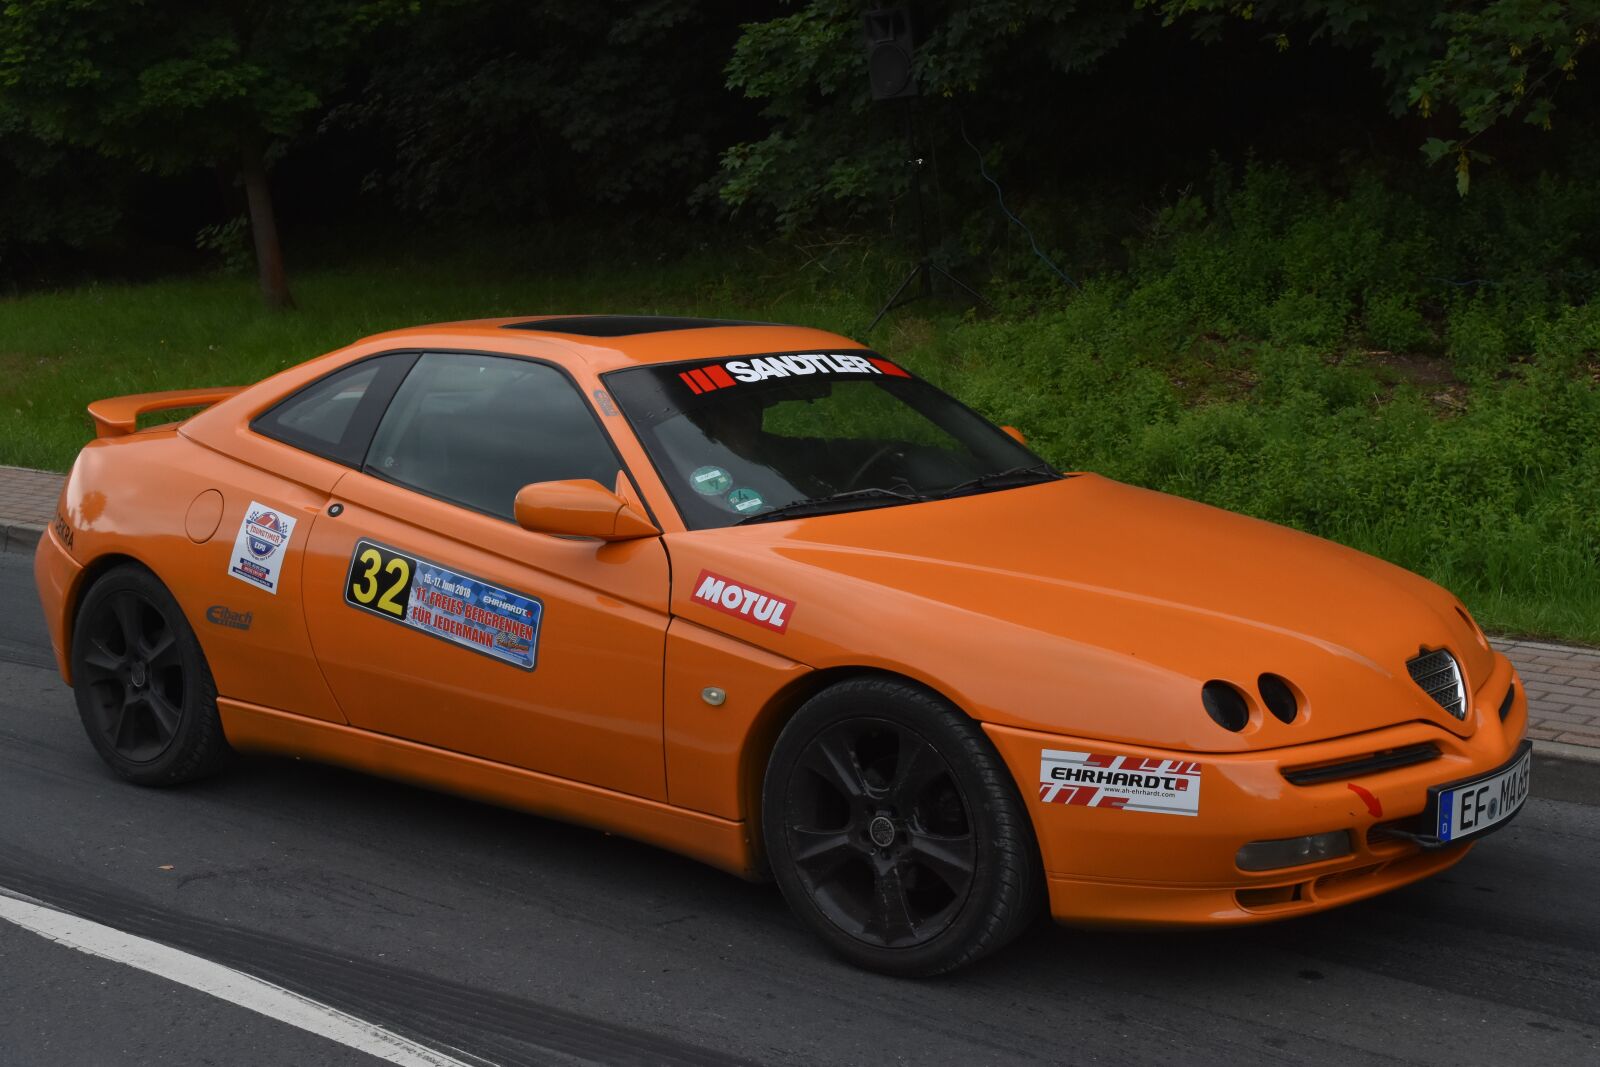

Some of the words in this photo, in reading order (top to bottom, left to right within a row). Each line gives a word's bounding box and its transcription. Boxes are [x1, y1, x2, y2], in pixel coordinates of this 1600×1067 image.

[725, 354, 883, 382] SANDTLER
[353, 548, 410, 616] 32
[441, 579, 456, 593] Juni
[455, 584, 471, 598] 2018
[415, 586, 428, 602] 11.
[429, 591, 463, 616] FREIES
[464, 603, 534, 642] BERGRENNEN
[483, 595, 528, 617] EHRHARDT
[695, 576, 787, 627] MOTUL
[412, 605, 432, 626] FÜR
[432, 614, 494, 649] JEDERMANN
[1051, 767, 1176, 791] EHRHARDT
[1104, 786, 1176, 798] www.ah-ehrhardt.com
[1460, 785, 1490, 831] EF
[1499, 771, 1517, 816] MA
[1442, 822, 1448, 834] D
